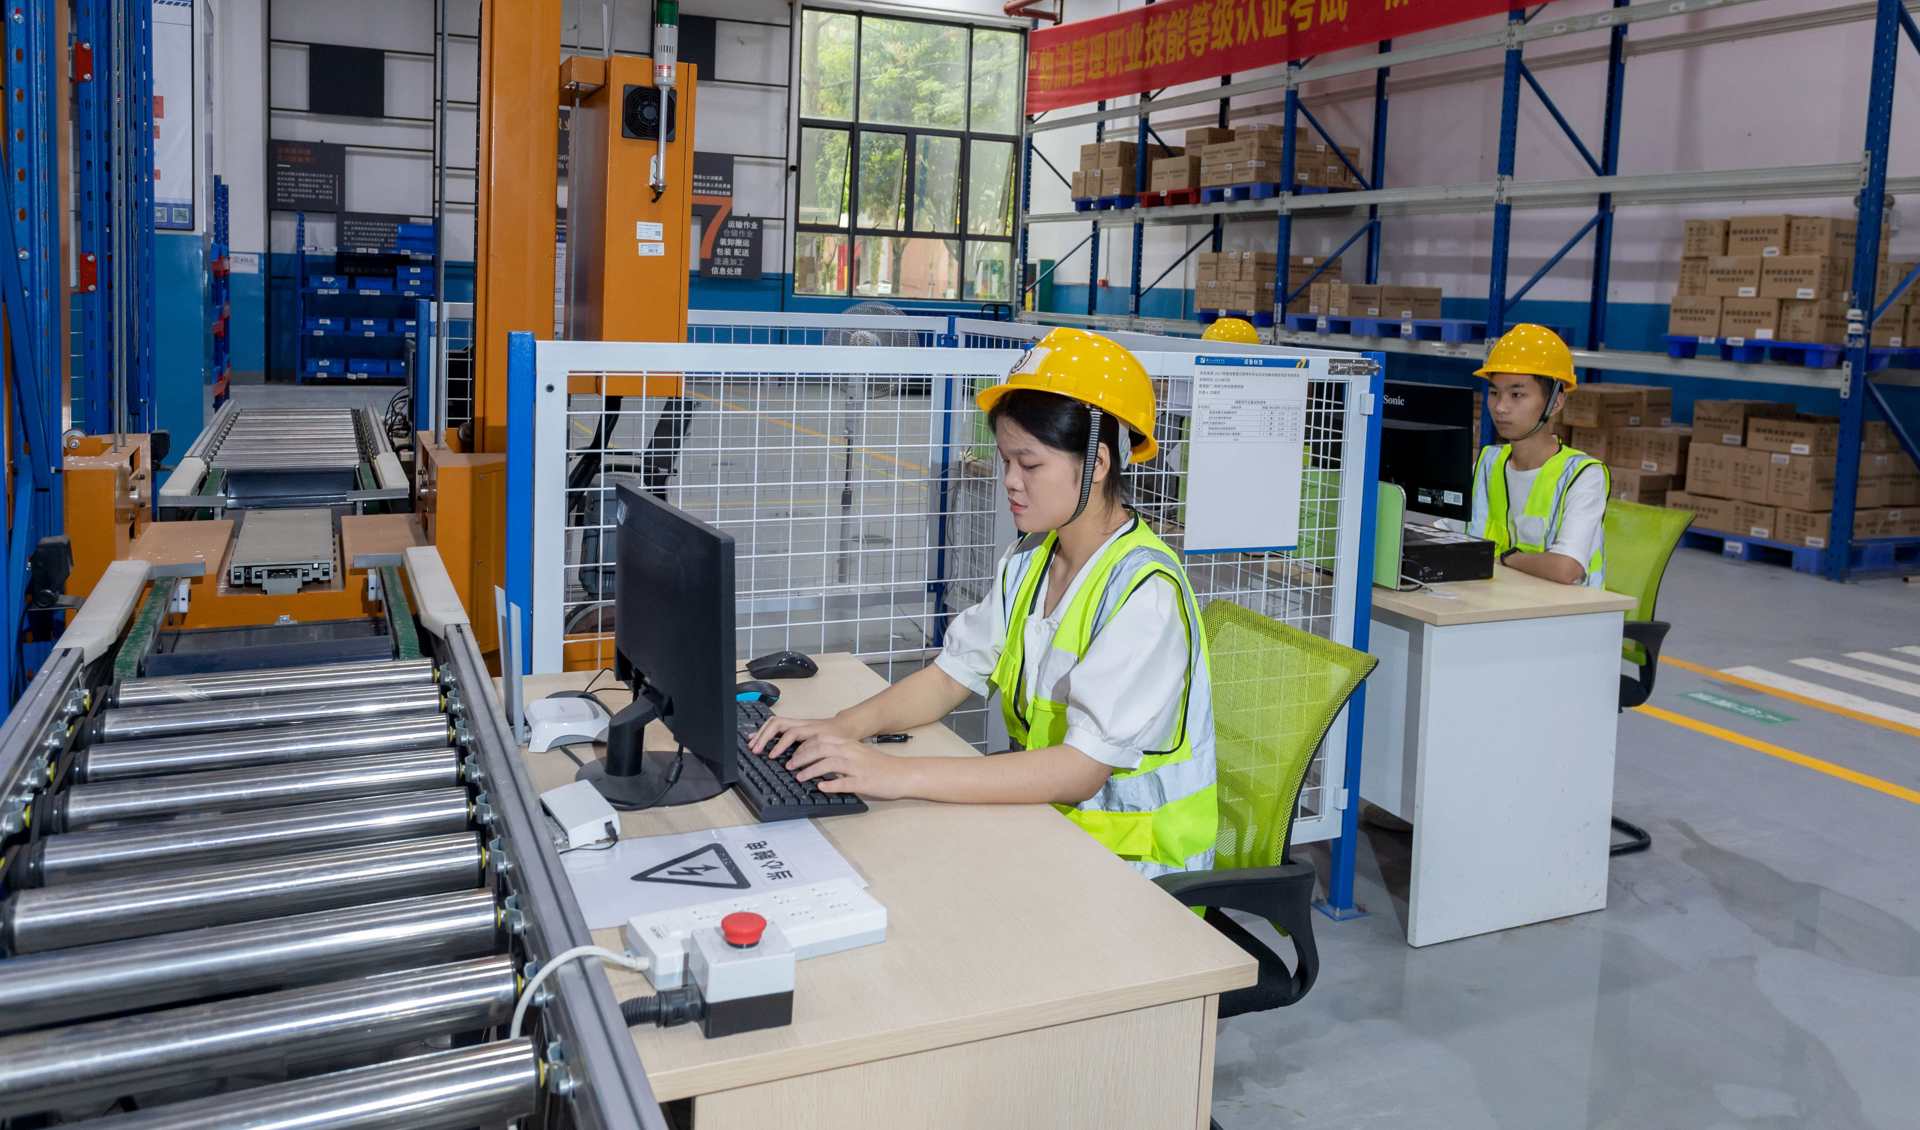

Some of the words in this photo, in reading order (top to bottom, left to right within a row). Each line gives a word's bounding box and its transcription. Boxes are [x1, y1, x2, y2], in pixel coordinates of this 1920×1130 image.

[692, 195, 732, 259] 7
[711, 266, 742, 275] 信息处理
